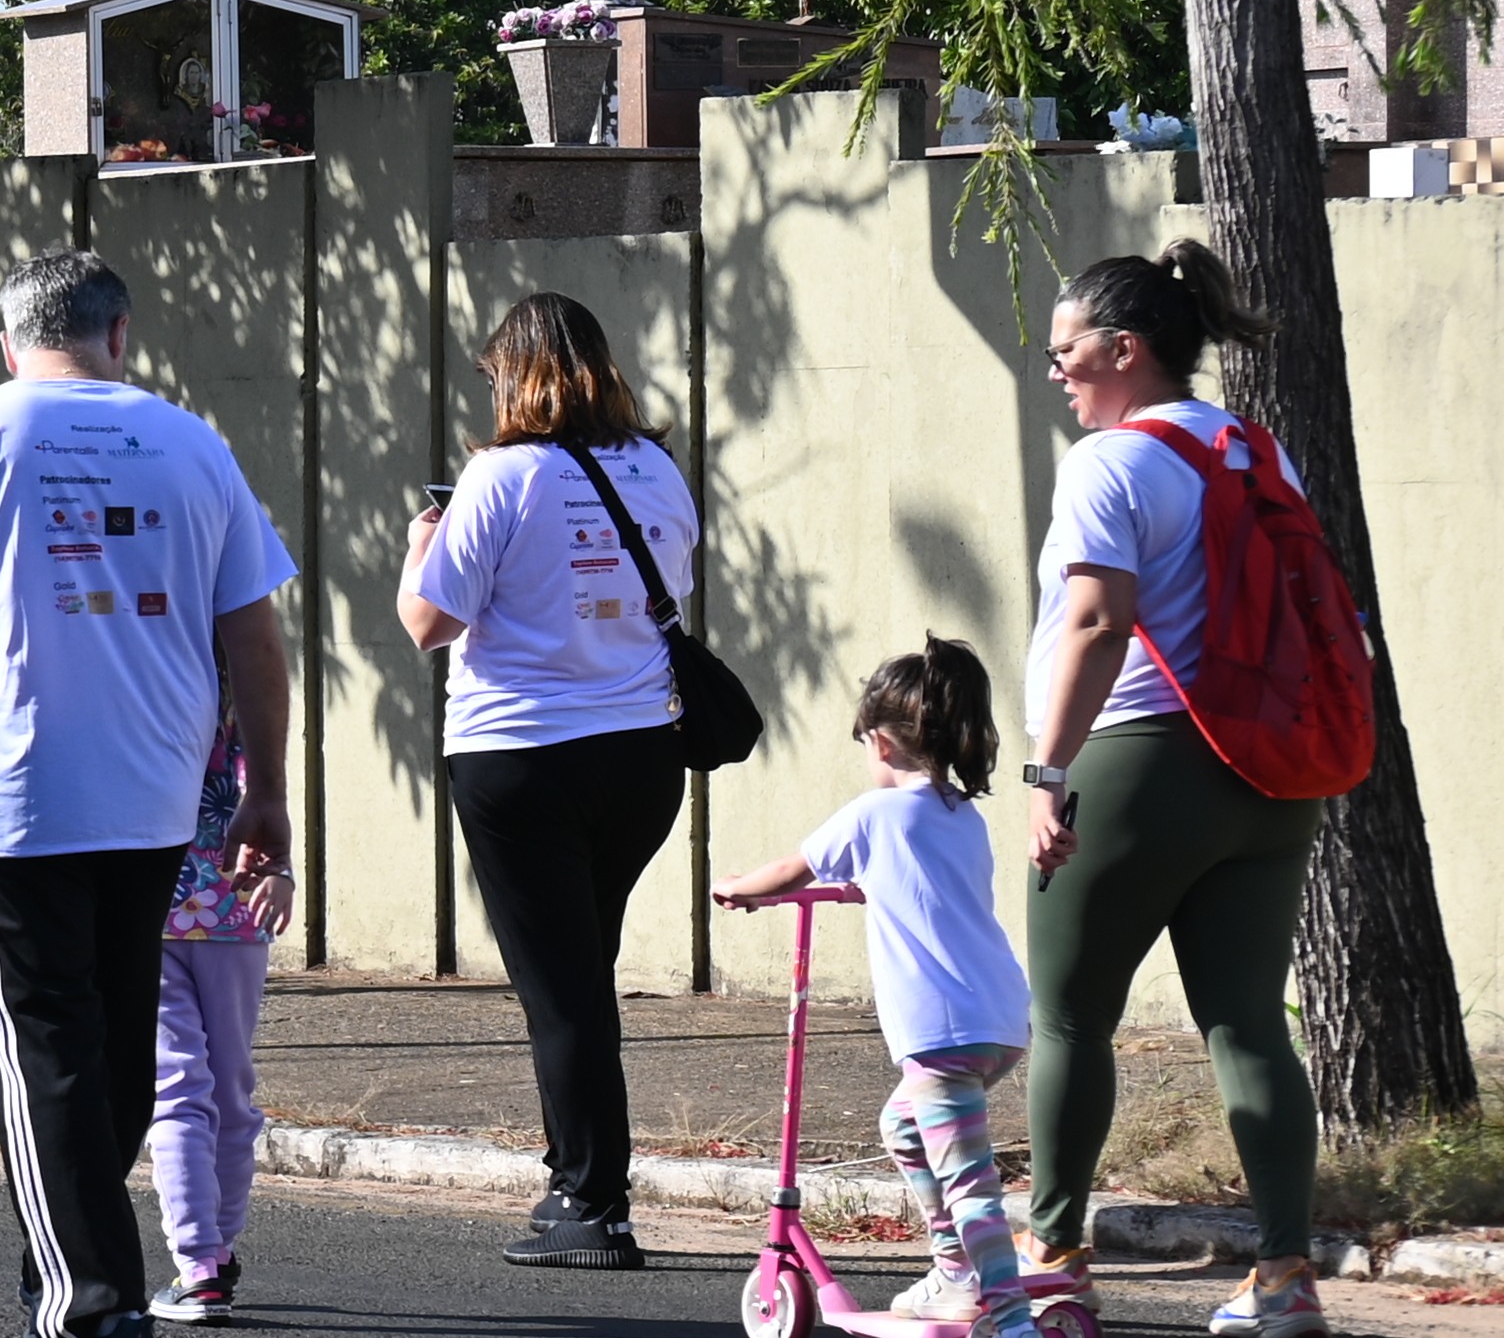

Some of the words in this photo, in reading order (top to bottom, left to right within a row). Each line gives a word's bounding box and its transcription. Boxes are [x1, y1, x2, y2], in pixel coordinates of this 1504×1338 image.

[71, 424, 123, 434] Realização
[40, 474, 111, 485] Patrocinadores
[53, 582, 76, 591] Gold
